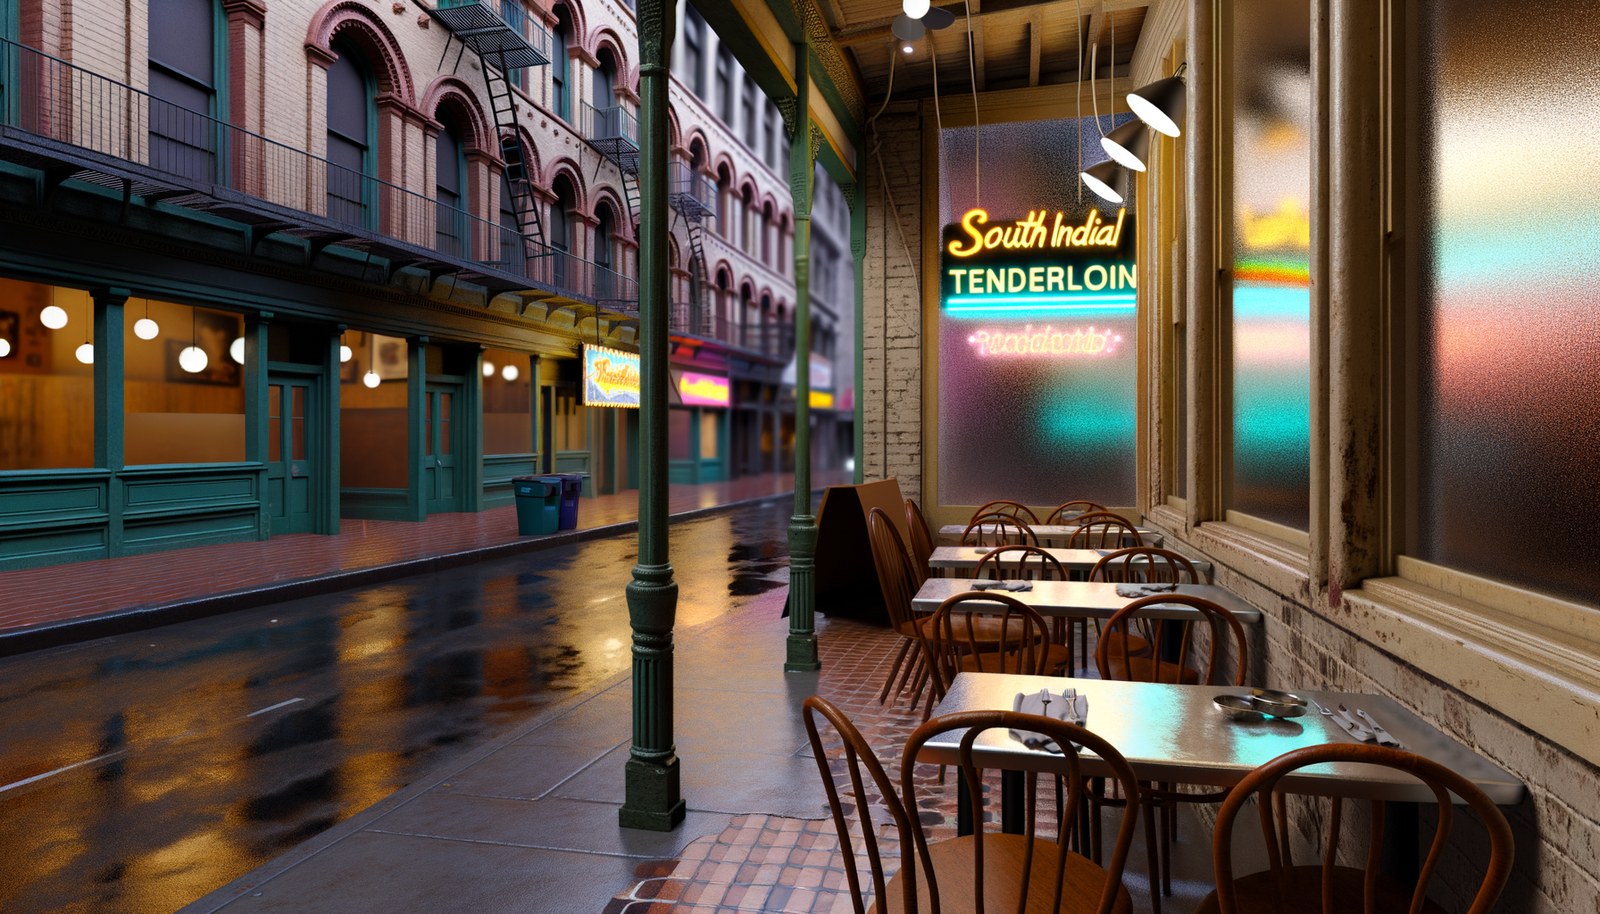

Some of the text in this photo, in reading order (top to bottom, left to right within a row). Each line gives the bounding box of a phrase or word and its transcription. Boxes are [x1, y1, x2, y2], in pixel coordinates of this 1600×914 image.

[948, 207, 1126, 257] South Indial
[948, 264, 1137, 294] TENDERLOIN
